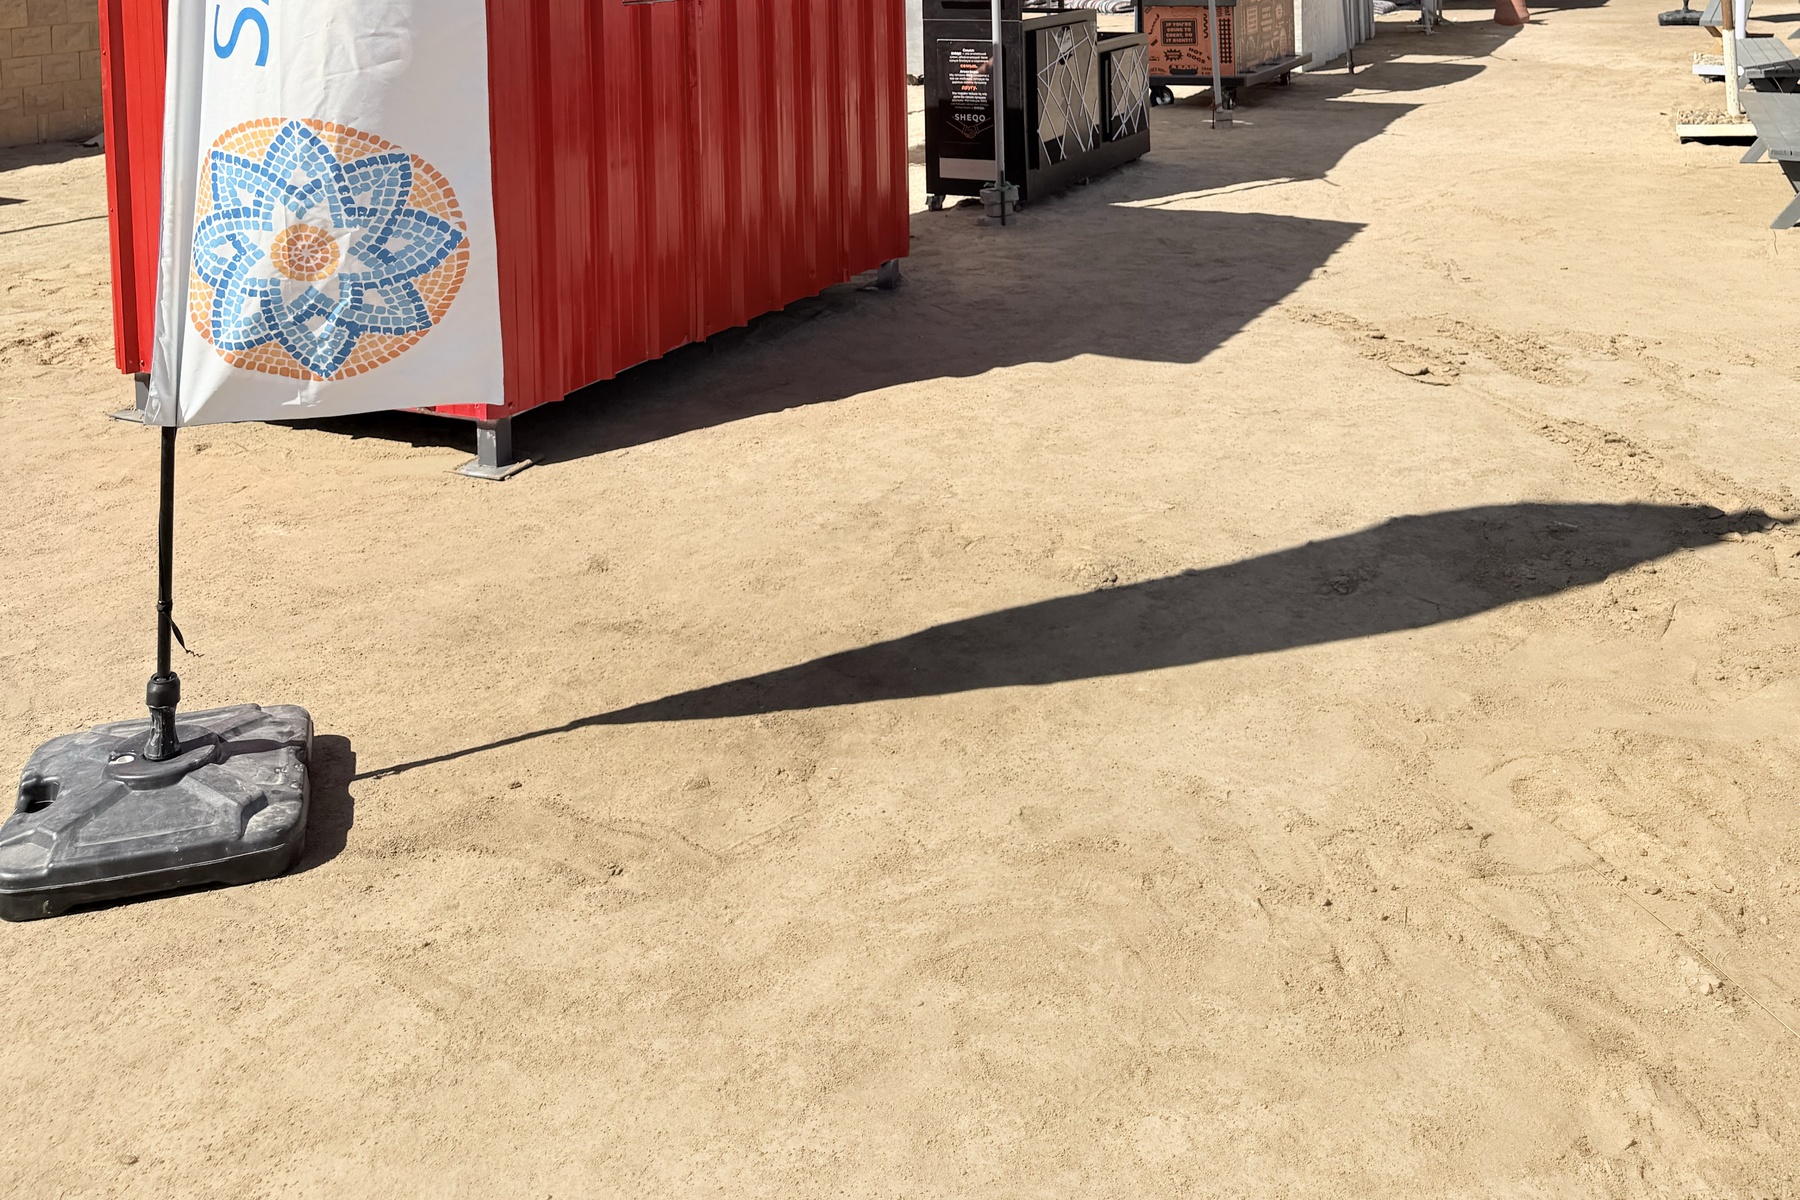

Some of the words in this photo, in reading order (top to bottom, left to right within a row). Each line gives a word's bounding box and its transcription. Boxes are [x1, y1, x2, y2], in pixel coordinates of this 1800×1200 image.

[1188, 47, 1203, 56] HOT
[1186, 52, 1206, 64] DOGS
[954, 113, 986, 123] SHEQO
